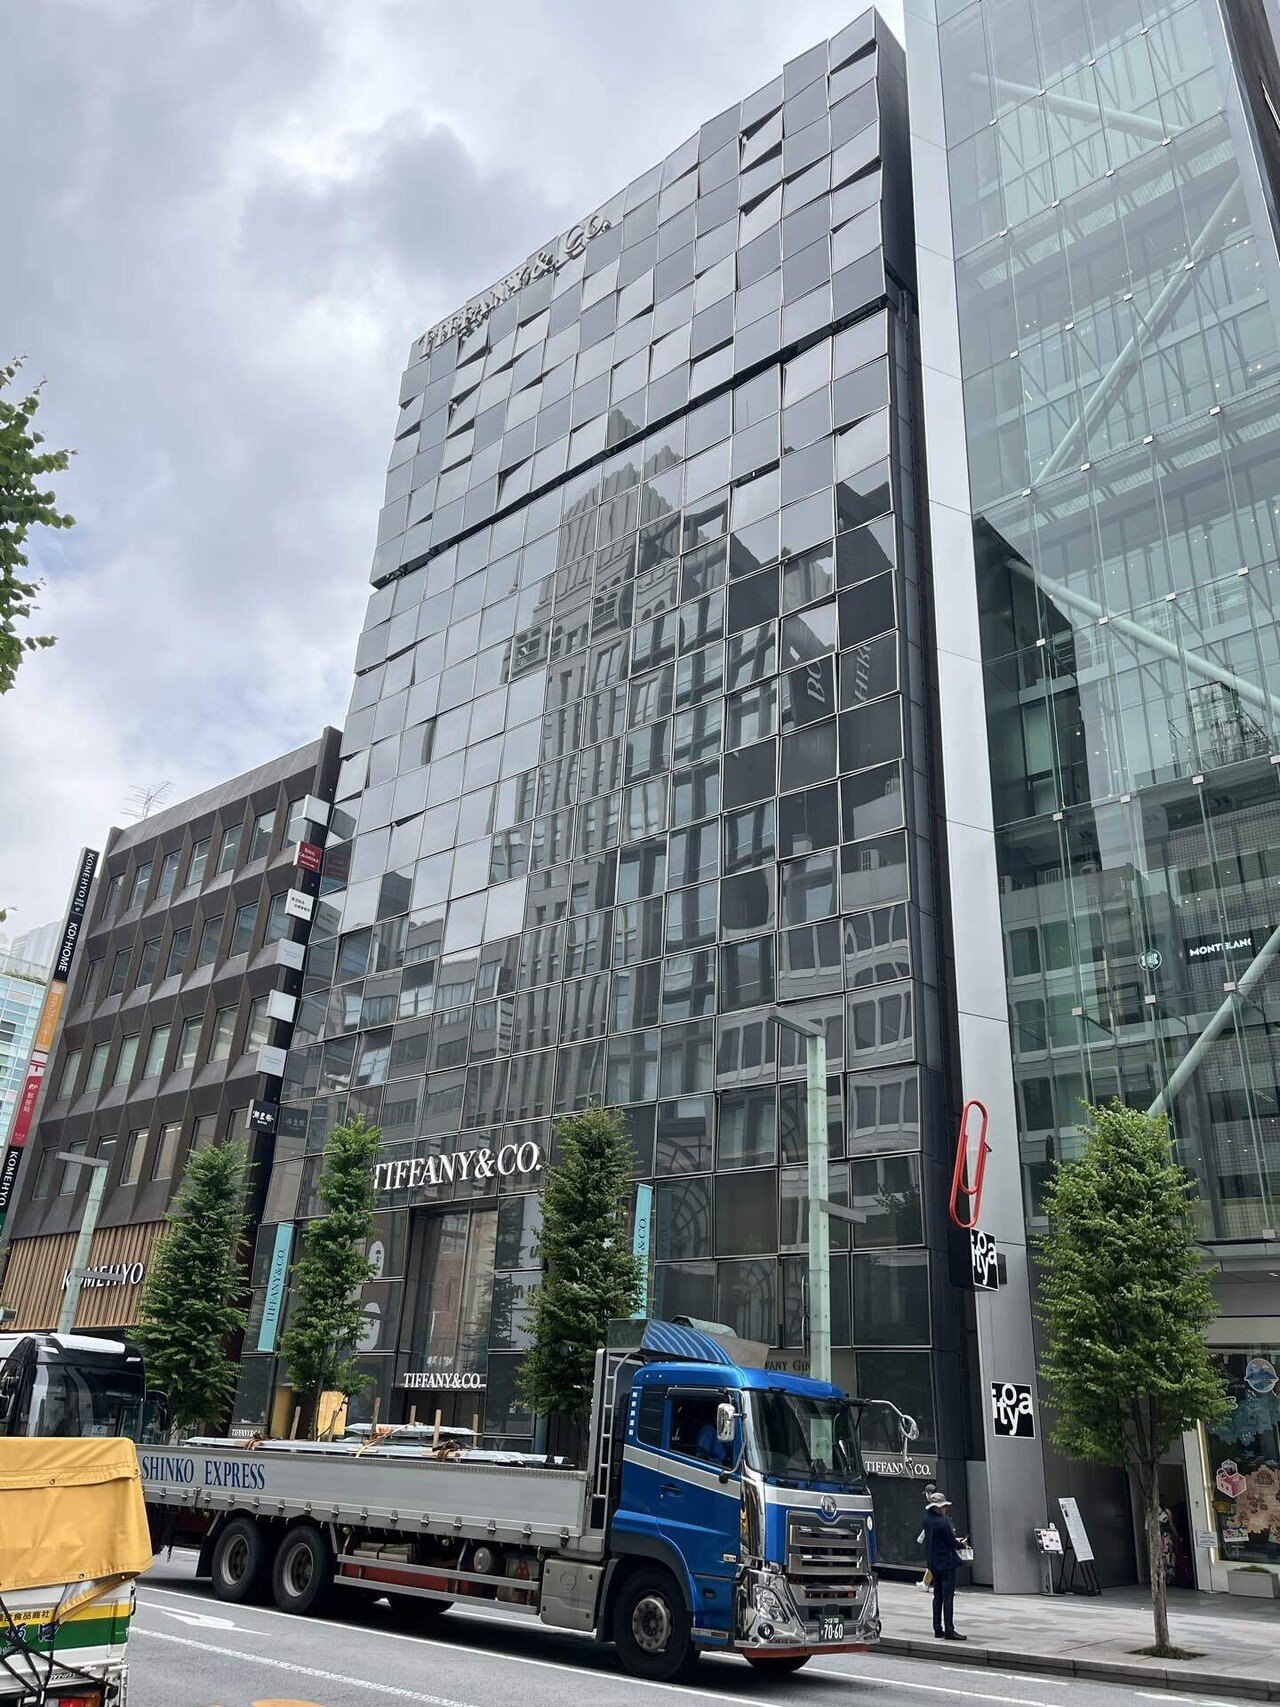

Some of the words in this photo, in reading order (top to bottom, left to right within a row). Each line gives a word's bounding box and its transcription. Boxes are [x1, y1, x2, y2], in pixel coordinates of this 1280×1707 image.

[78, 852, 95, 898] KOMEHYO
[61, 1262, 144, 1290] KMEHYO
[142, 1455, 195, 1484] SHINKO
[204, 1460, 266, 1490] EXPRESS
